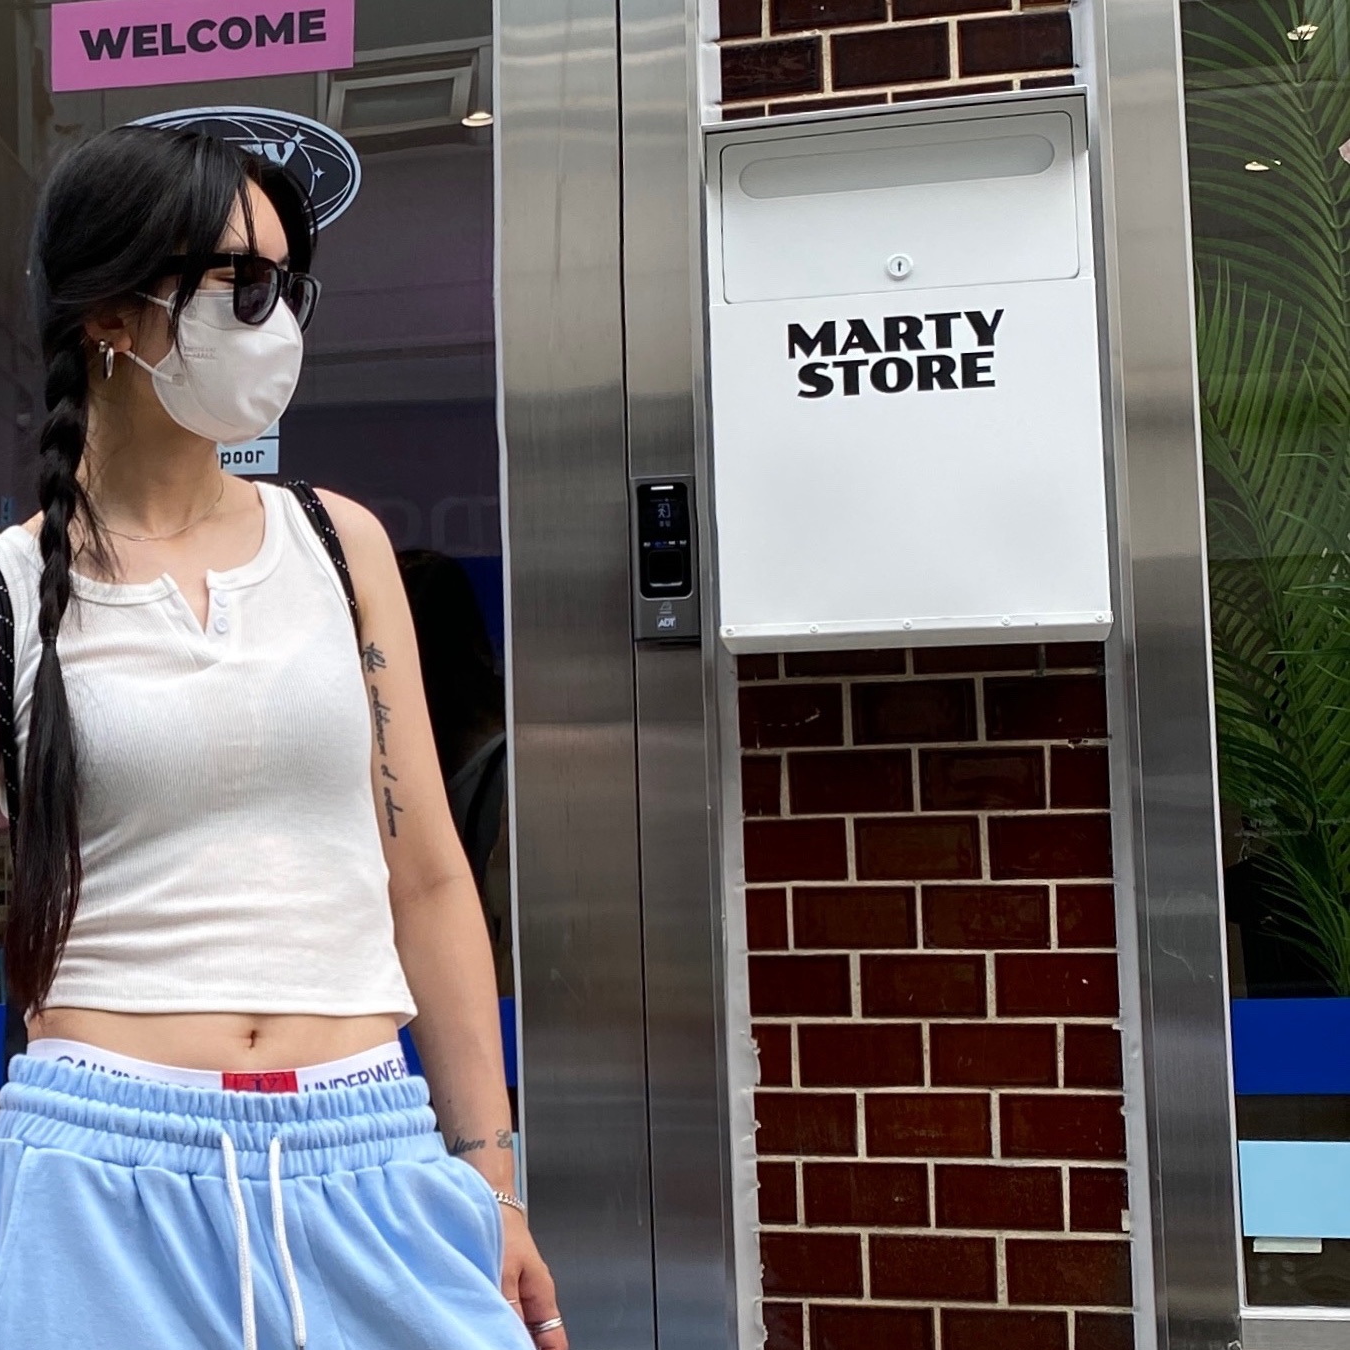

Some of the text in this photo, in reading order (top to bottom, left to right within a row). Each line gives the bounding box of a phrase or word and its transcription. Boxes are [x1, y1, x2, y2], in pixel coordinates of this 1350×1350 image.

[79, 9, 327, 61] WELCOME
[787, 308, 1005, 360] MARTY
[797, 351, 996, 399] STORE
[657, 617, 676, 628] ADT
